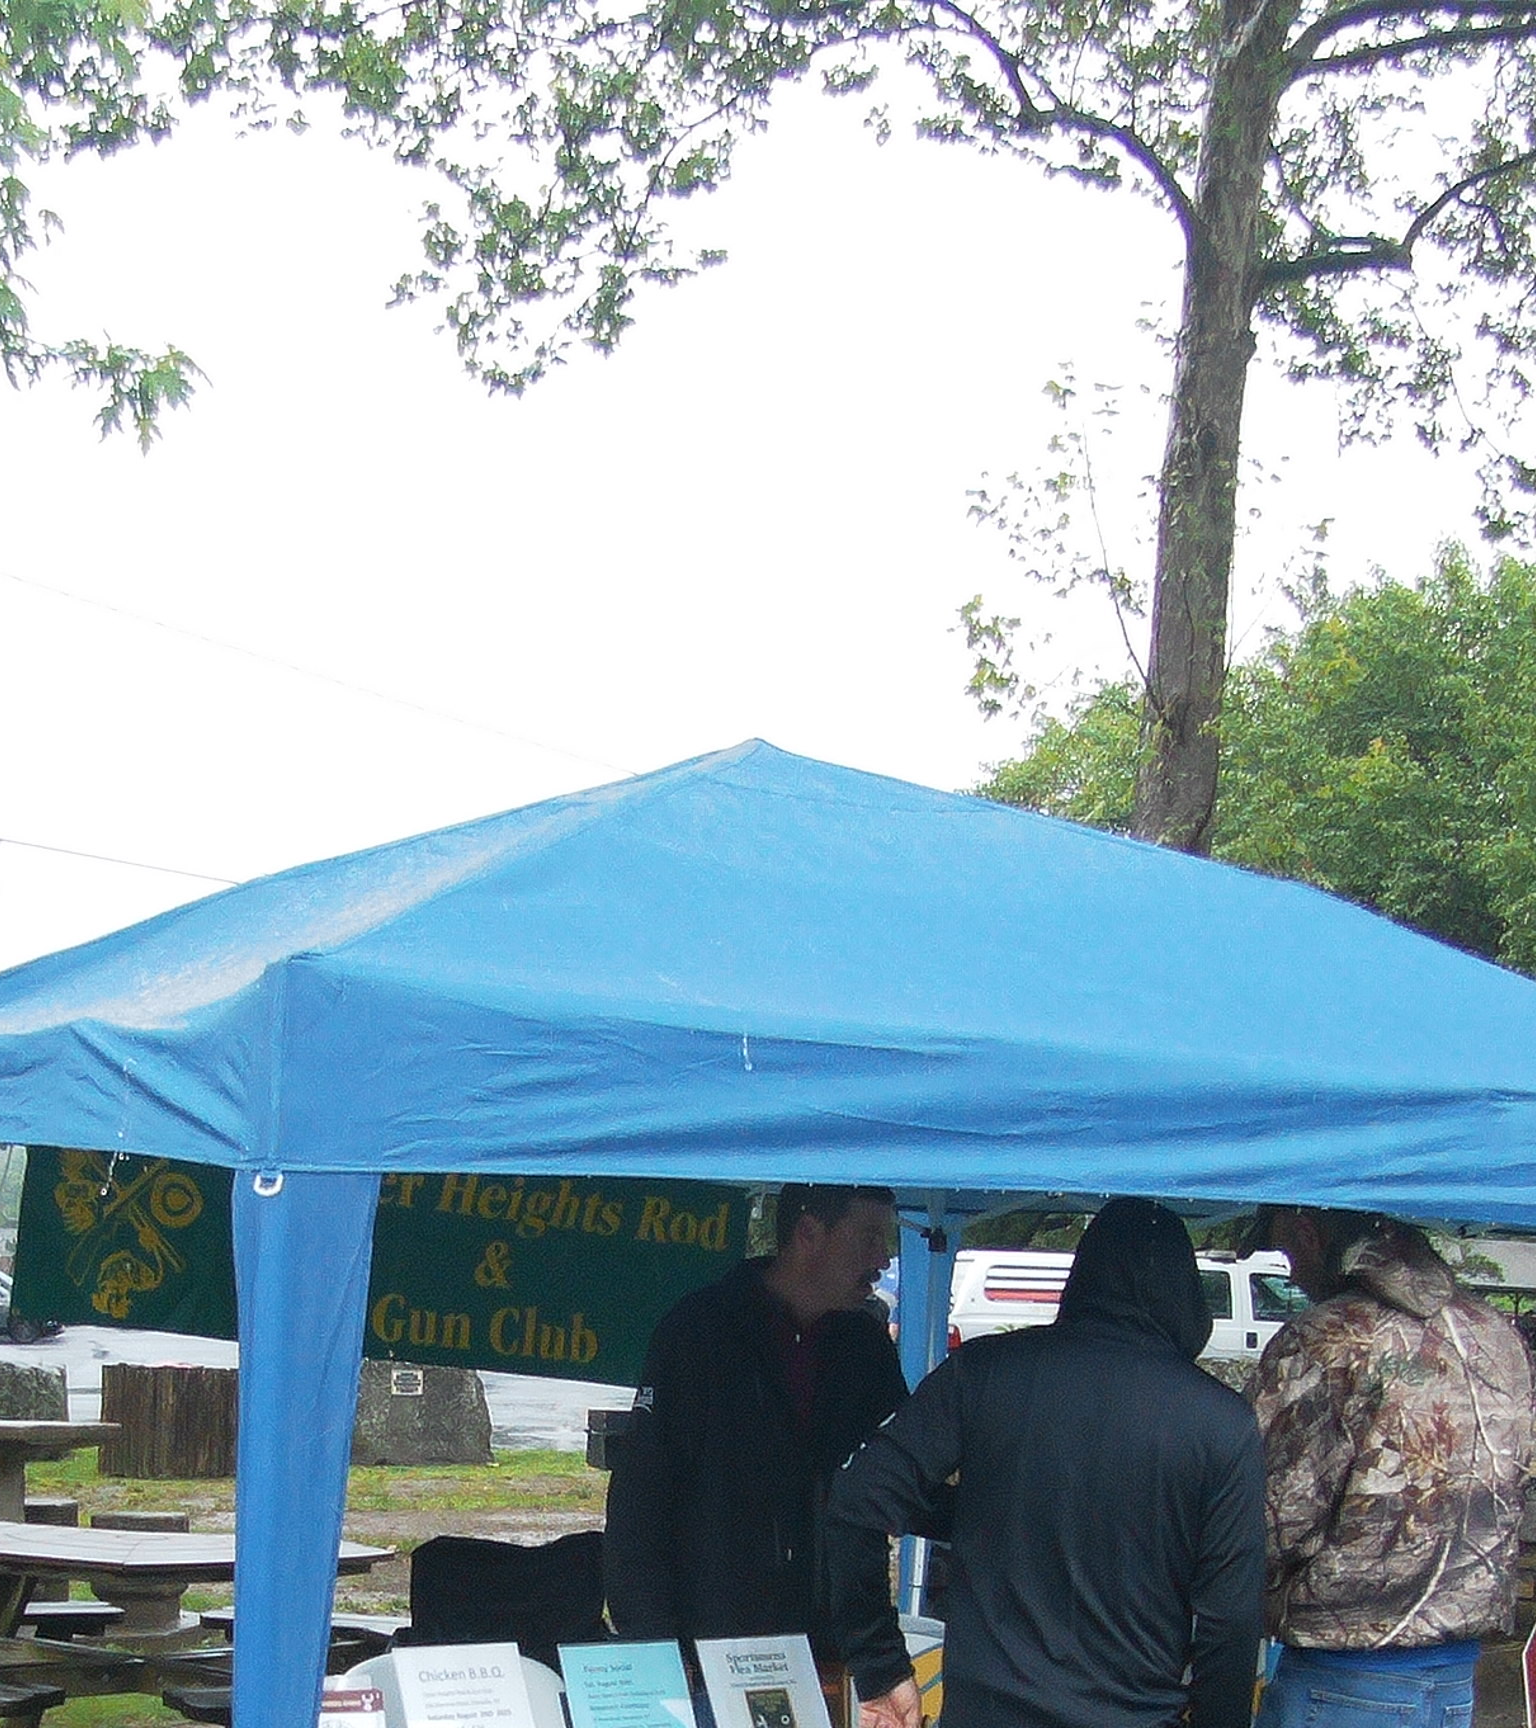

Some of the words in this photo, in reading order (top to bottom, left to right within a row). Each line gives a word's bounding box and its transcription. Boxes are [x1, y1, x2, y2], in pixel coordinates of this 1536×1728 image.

[435, 1175, 624, 1239] Heights
[634, 1195, 731, 1251] Rod
[474, 1240, 513, 1288] &
[371, 1293, 471, 1349] Gun
[488, 1307, 599, 1363] Club
[418, 1667, 466, 1683] Chicken
[753, 1661, 790, 1674] Market
